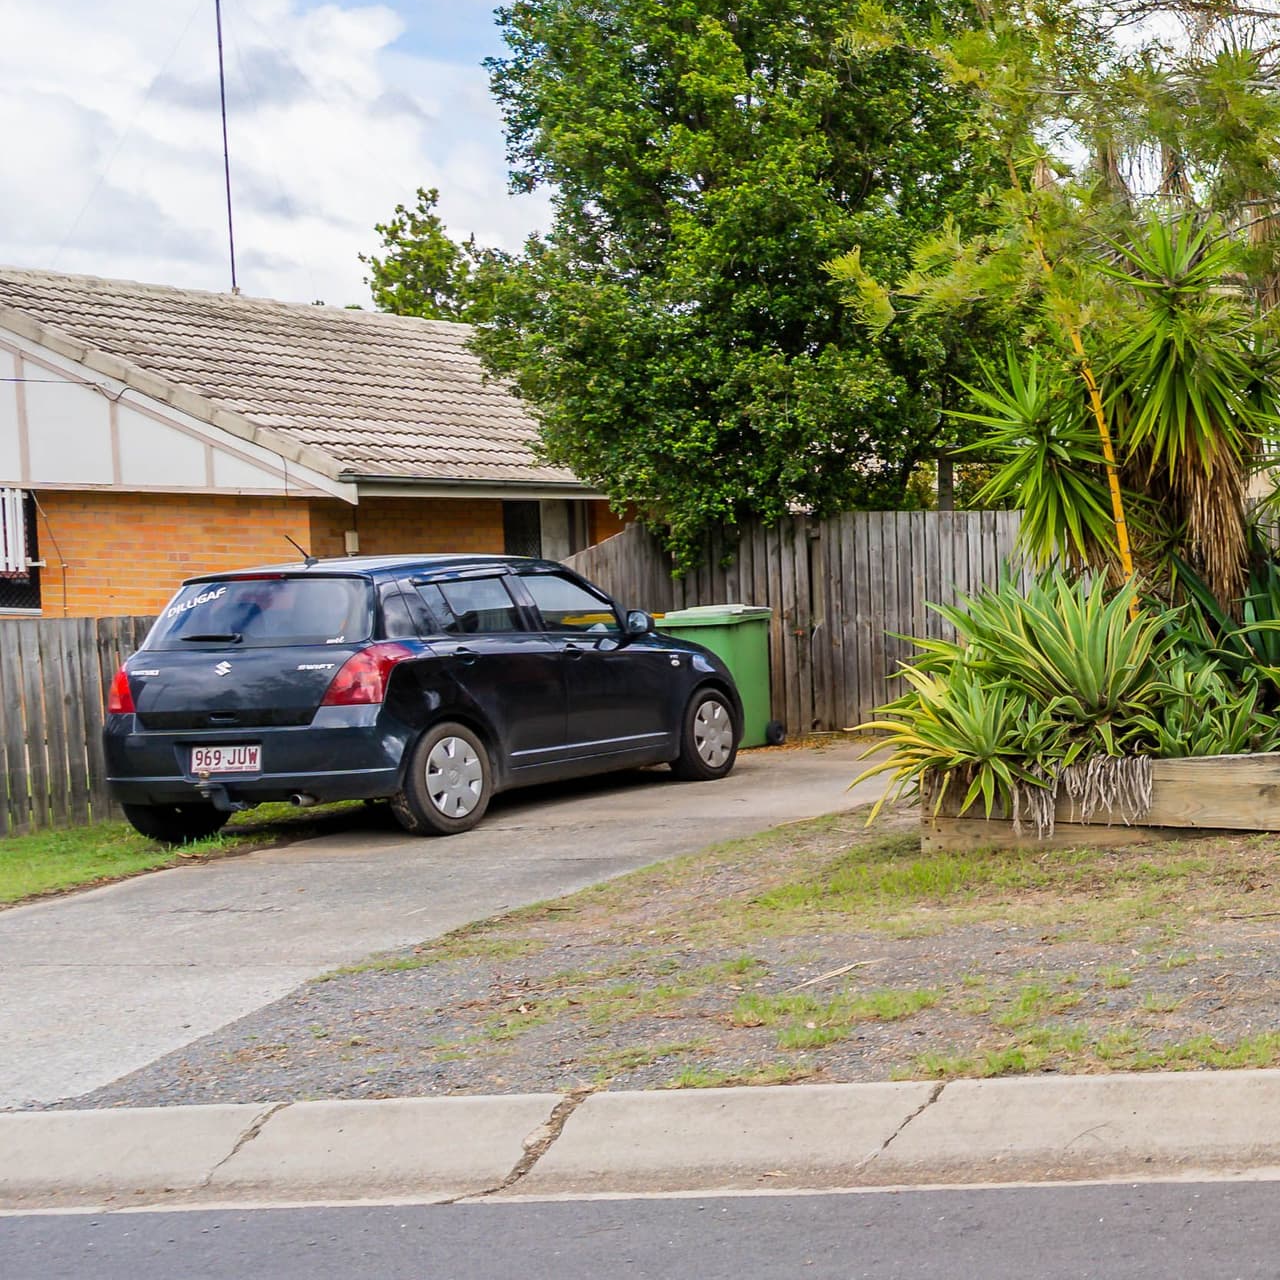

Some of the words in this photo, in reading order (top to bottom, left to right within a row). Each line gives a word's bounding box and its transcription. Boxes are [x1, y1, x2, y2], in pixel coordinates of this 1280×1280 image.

[168, 587, 227, 618] DILLIGAF
[195, 750, 222, 767] 969
[227, 748, 258, 765] JUW
